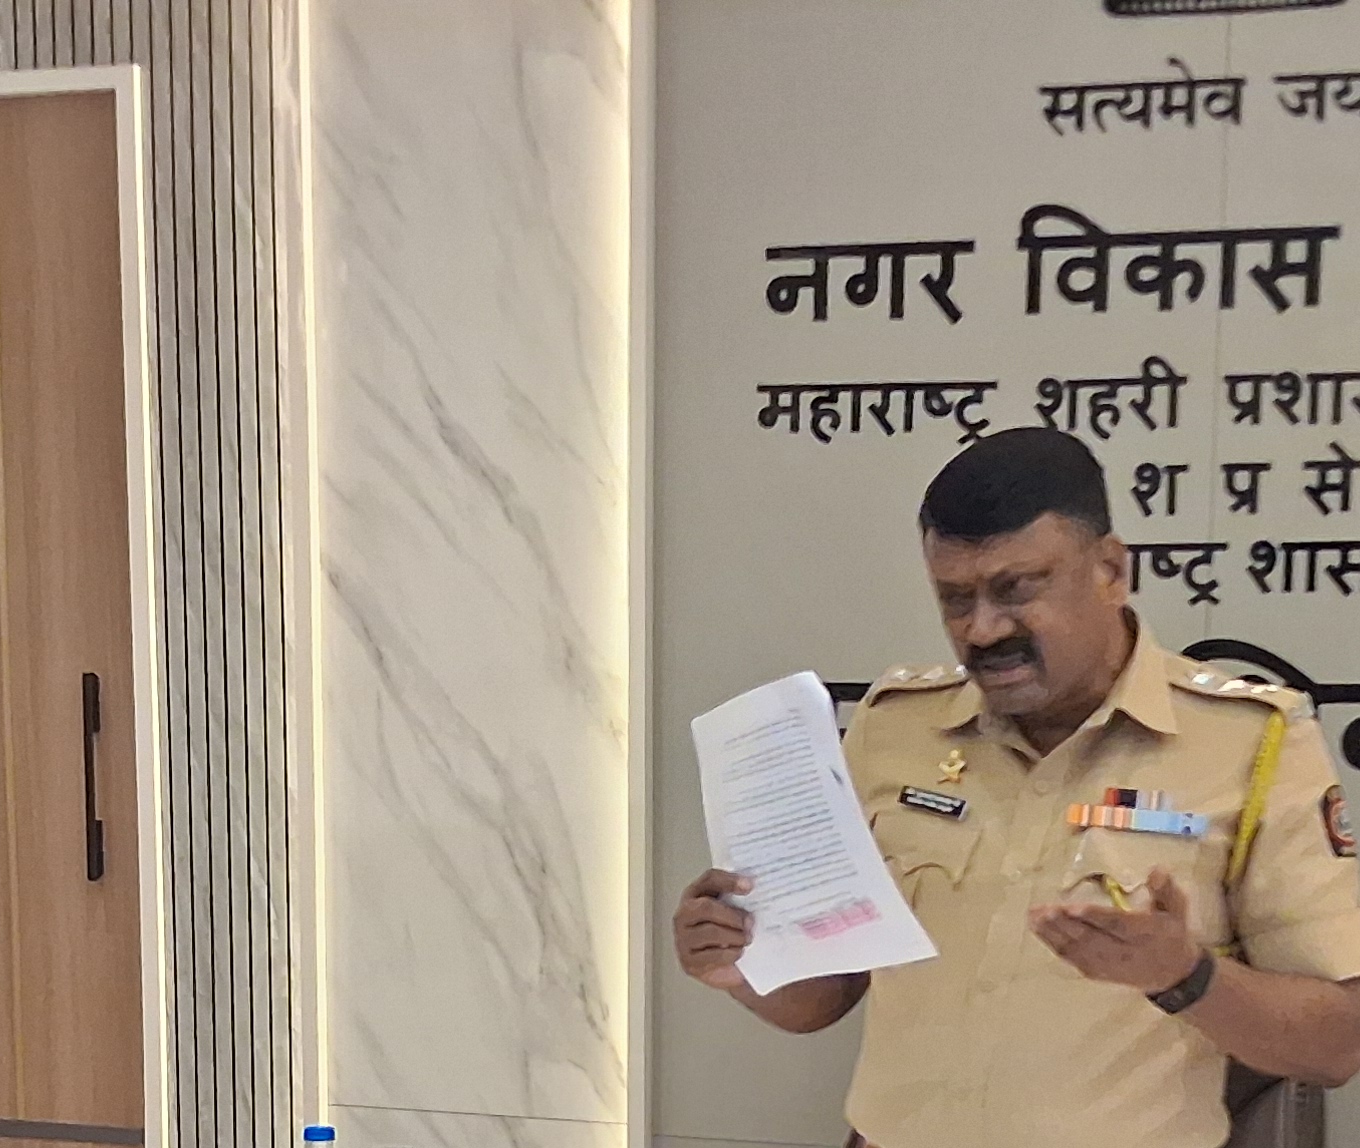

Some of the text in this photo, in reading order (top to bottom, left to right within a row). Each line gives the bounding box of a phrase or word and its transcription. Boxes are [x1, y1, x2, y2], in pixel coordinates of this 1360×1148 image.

[1038, 57, 1247, 137] सत्यमेव
[764, 239, 976, 325] नगर
[1016, 203, 1341, 316] विकास
[756, 380, 999, 444] महाराष्ट्र
[1036, 355, 1188, 440] शहरी
[1130, 462, 1189, 518] श
